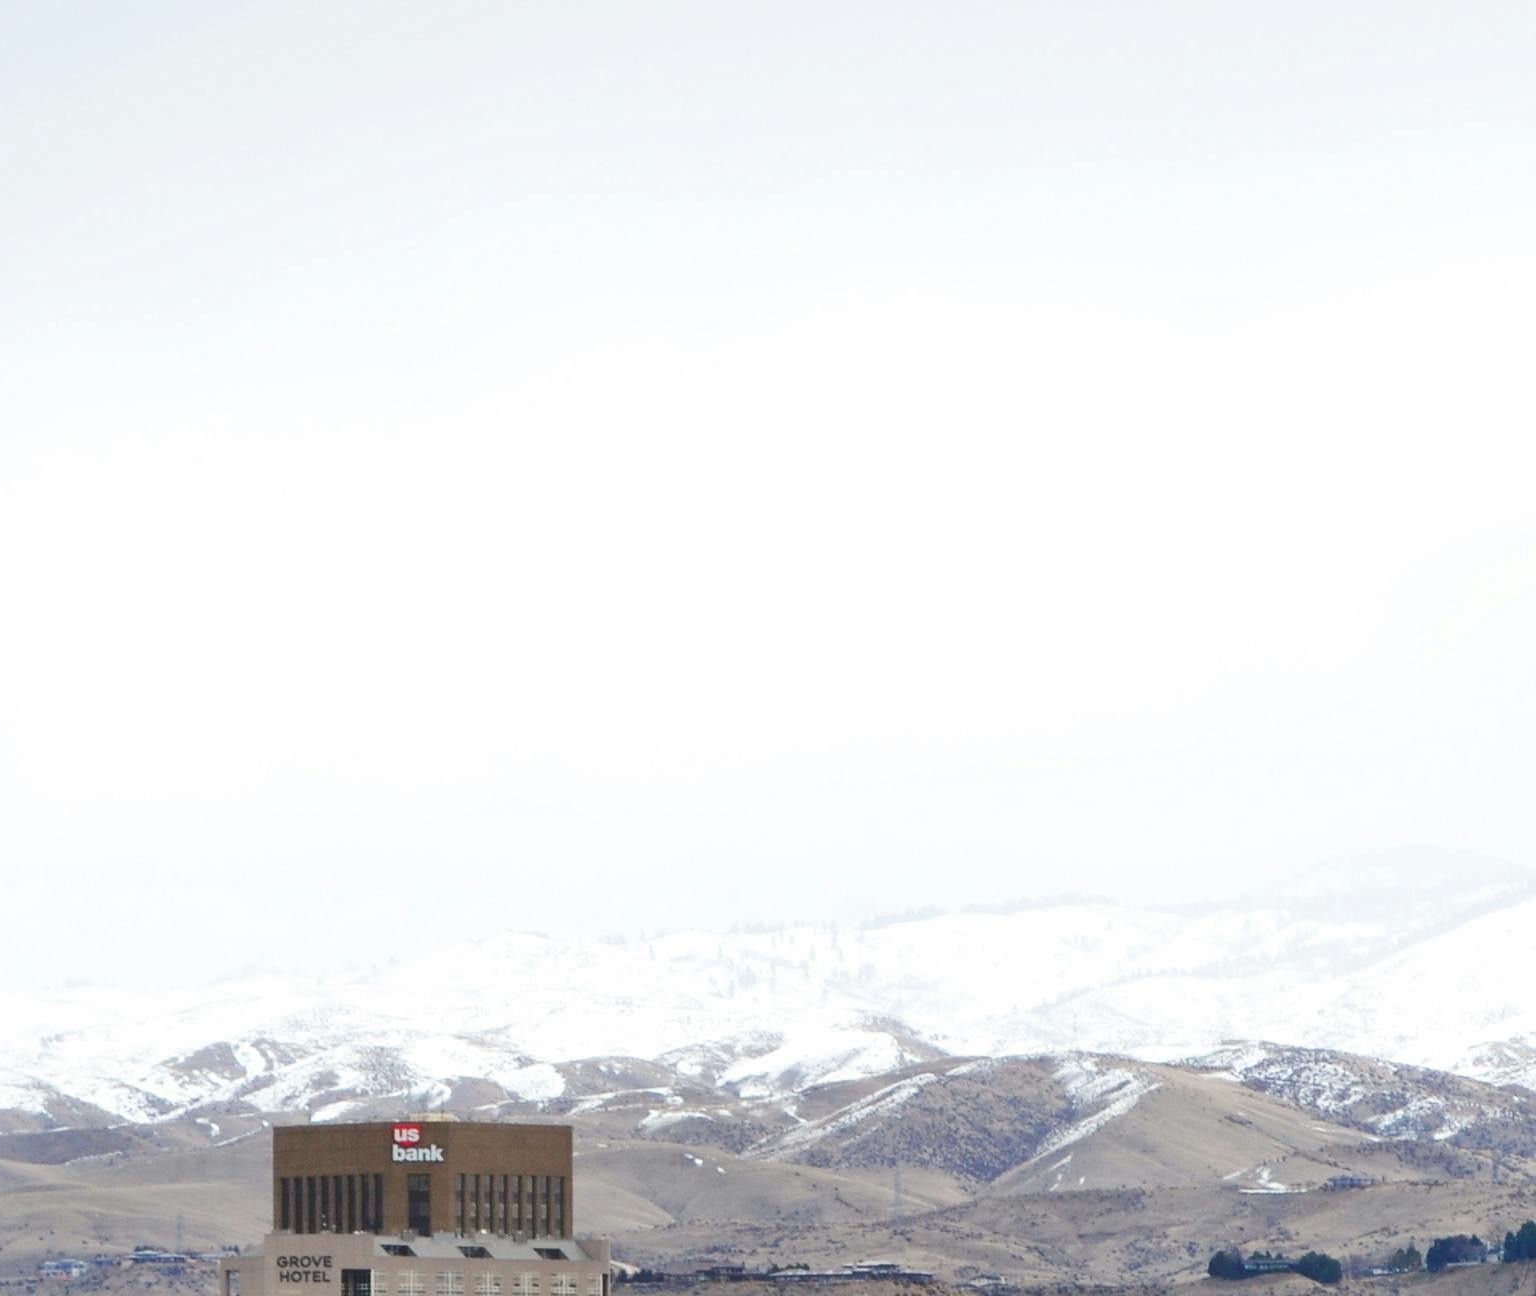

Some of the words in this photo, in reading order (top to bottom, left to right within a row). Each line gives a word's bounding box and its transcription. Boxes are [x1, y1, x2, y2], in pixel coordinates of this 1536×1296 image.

[394, 1128, 420, 1142] us
[392, 1144, 444, 1161] bank
[276, 1255, 333, 1268] GROVE
[279, 1270, 331, 1283] HOTEL
